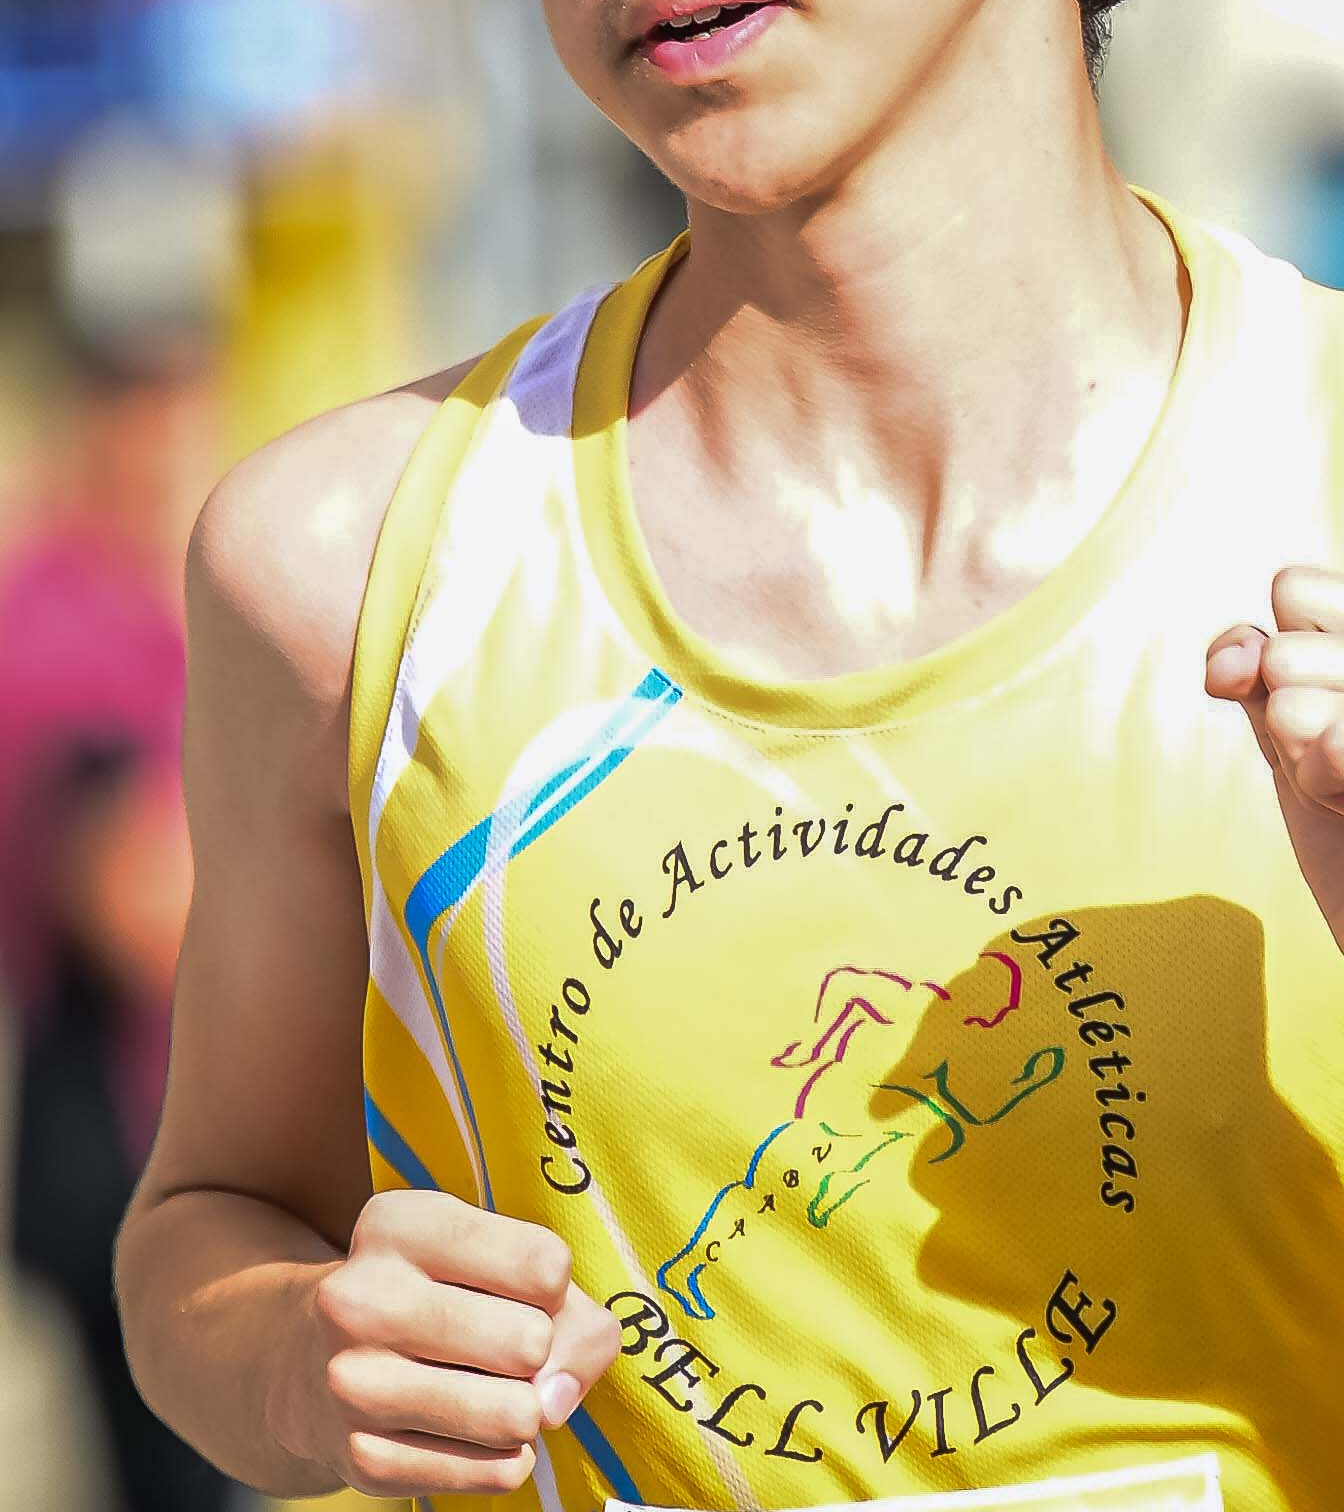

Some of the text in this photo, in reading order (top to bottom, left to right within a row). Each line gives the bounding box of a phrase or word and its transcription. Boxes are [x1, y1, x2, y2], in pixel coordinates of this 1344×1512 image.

[540, 803, 1147, 1214] Centro de Actividades Atléticas
[605, 1269, 1116, 1464] BELL VILLE
